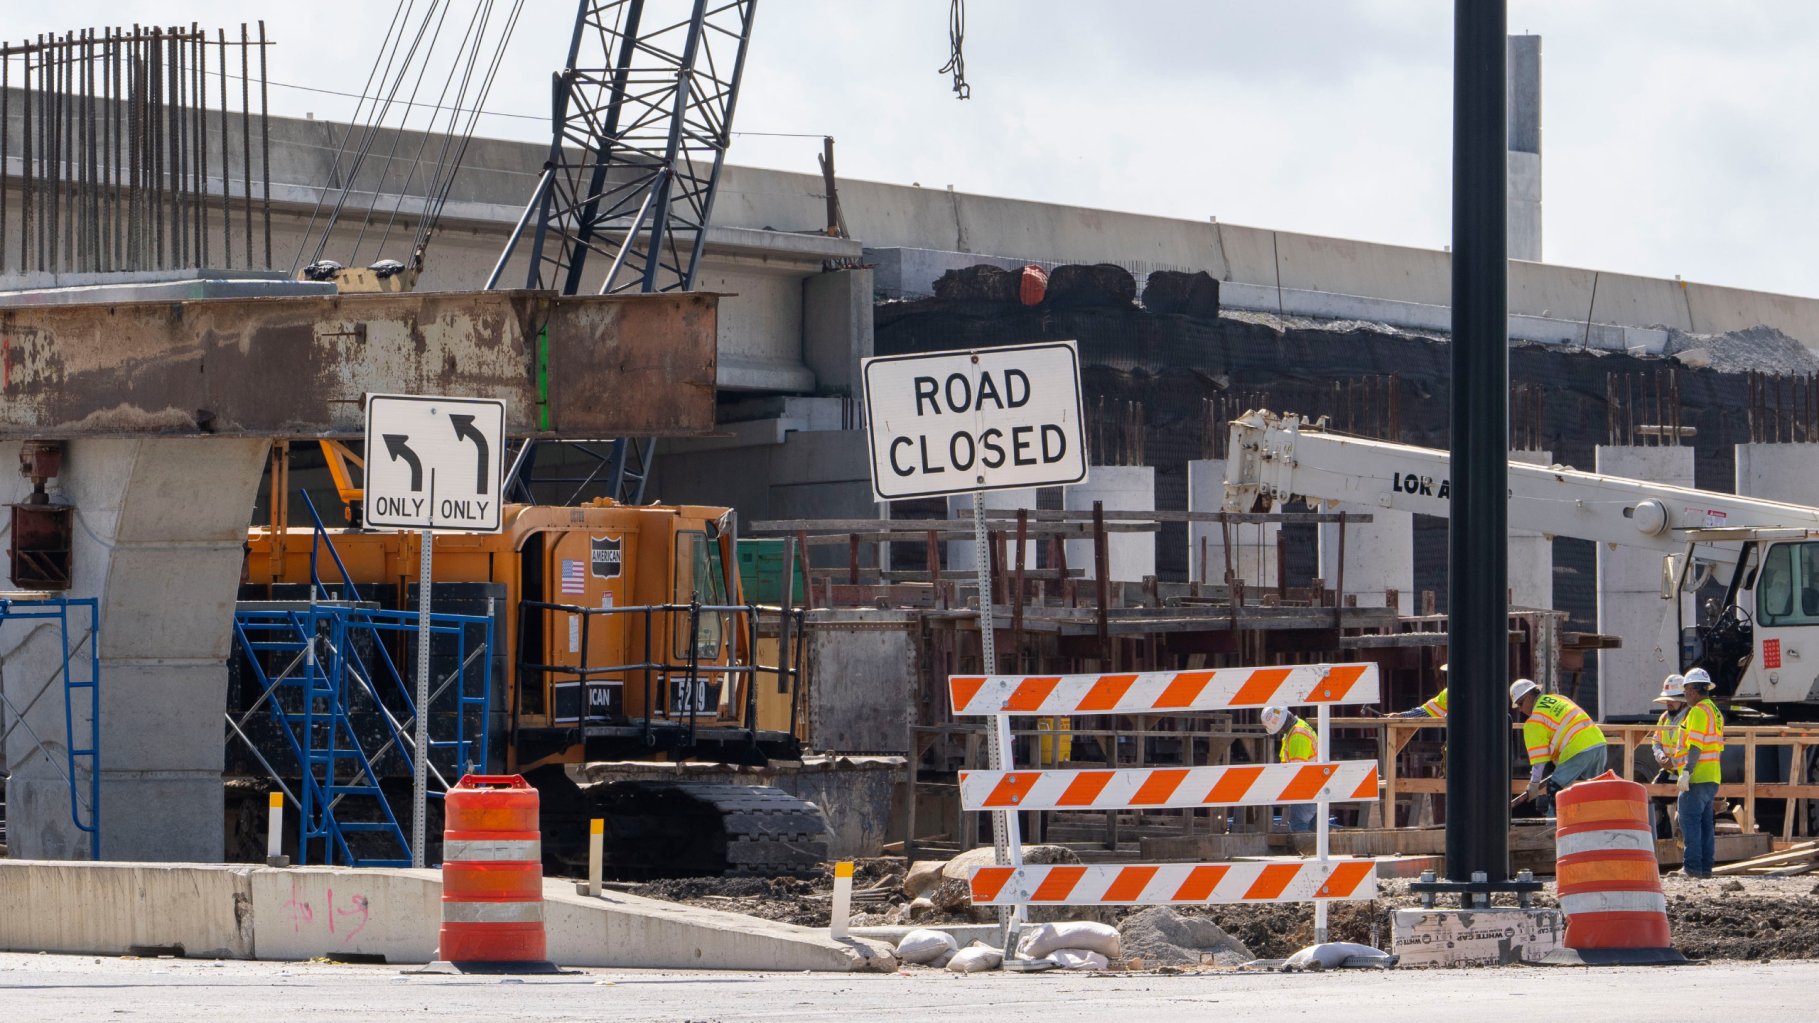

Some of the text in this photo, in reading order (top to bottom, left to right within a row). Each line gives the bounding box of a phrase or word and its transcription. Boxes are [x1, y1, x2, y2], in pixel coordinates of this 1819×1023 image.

[914, 368, 1031, 416] ROAD
[890, 424, 1067, 477] CLOSED
[376, 496, 424, 517] ONLY
[441, 499, 489, 520] ONLY
[592, 549, 620, 562] AMERICAN
[678, 681, 706, 711] 529
